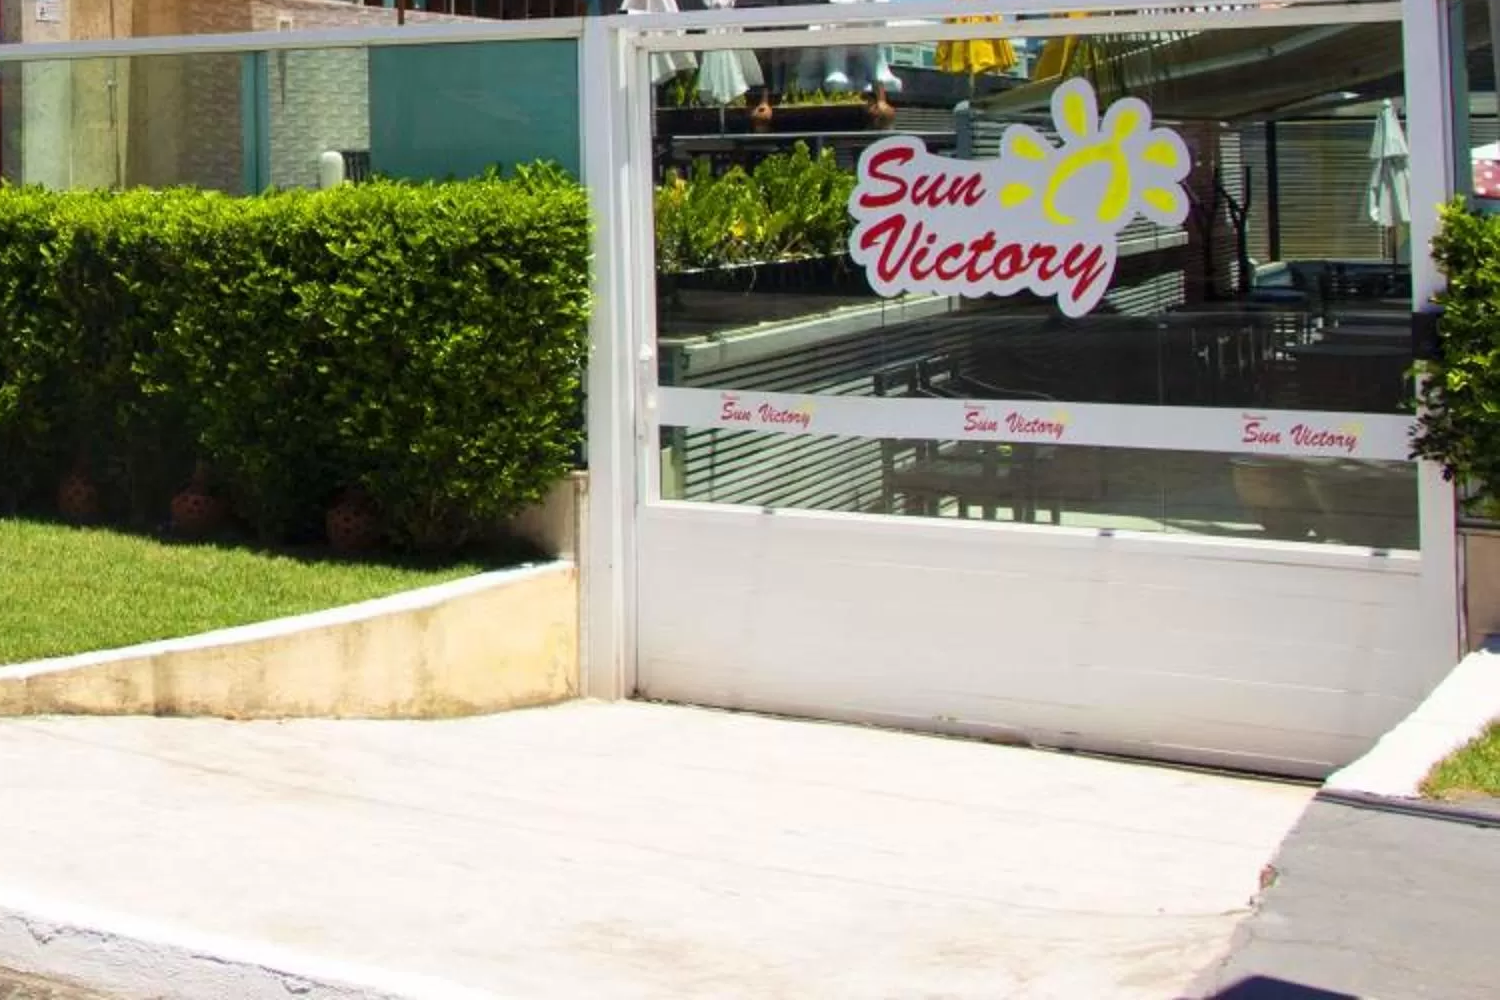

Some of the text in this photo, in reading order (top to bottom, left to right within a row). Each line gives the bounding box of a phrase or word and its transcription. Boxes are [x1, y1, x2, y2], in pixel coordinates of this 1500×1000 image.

[859, 147, 985, 208] Sun
[859, 213, 1105, 302] Victory
[721, 401, 811, 429] Sun Victory
[963, 411, 1064, 440] Sun Victory
[1242, 421, 1357, 452] Sun Victory
